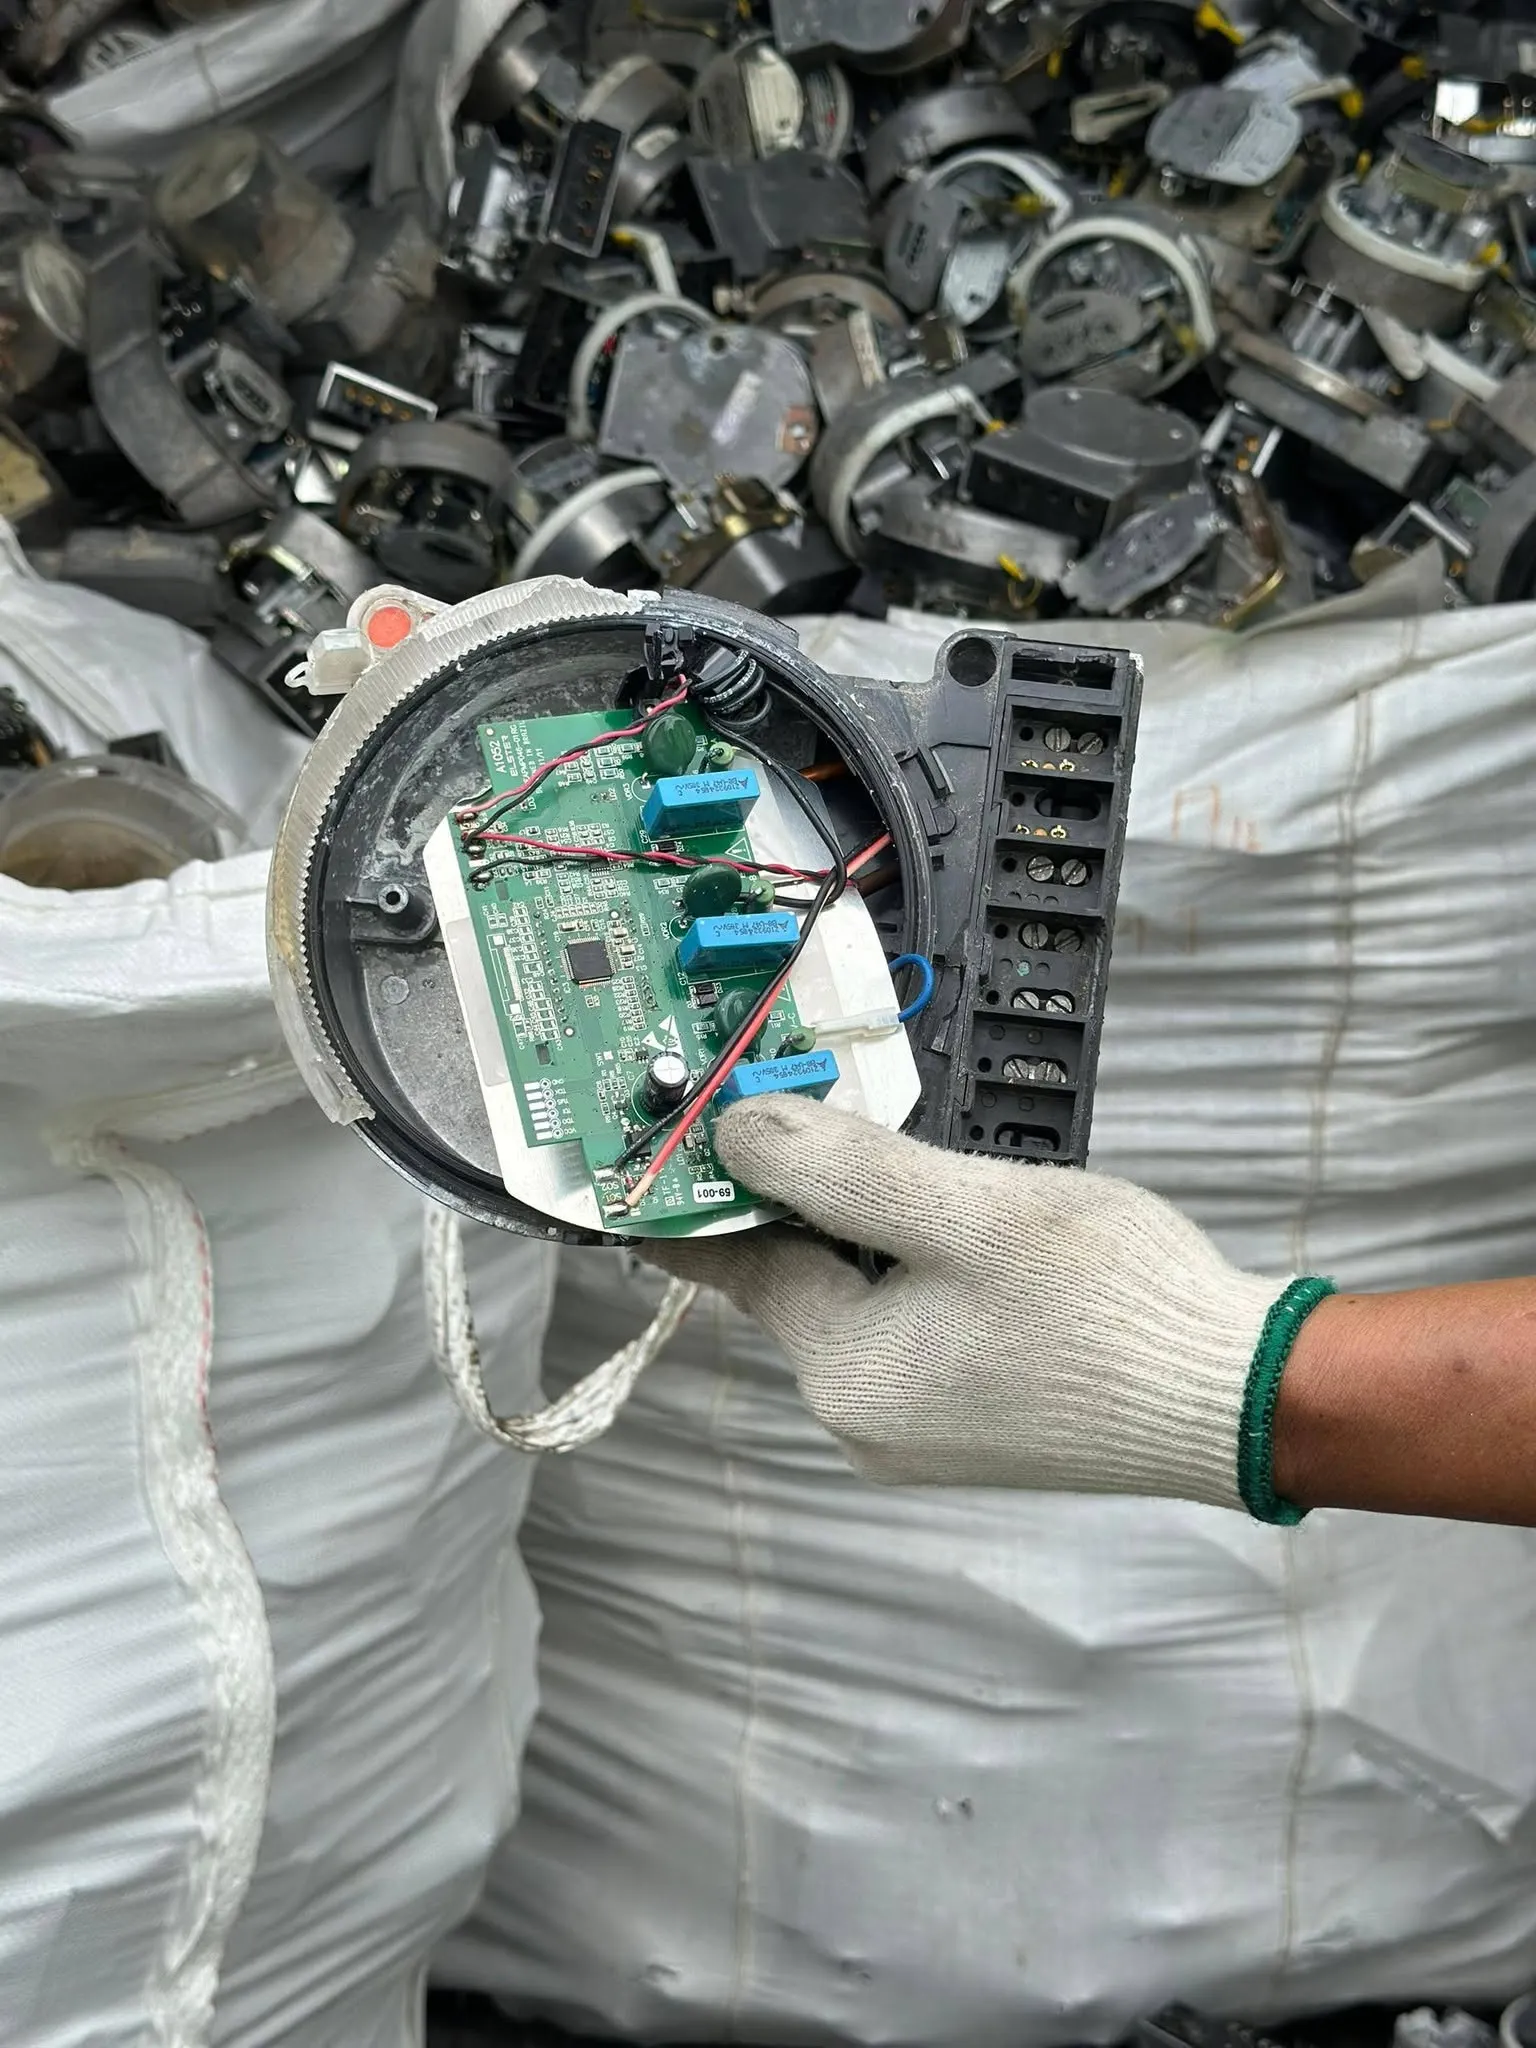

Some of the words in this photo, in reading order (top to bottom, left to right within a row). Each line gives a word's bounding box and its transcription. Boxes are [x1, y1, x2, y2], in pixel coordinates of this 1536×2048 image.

[489, 740, 507, 773] A1052
[501, 735, 518, 776] ELSTER
[639, 829, 648, 844] C29
[660, 922, 671, 940] VDR2
[697, 1188, 731, 1198] 59-001
